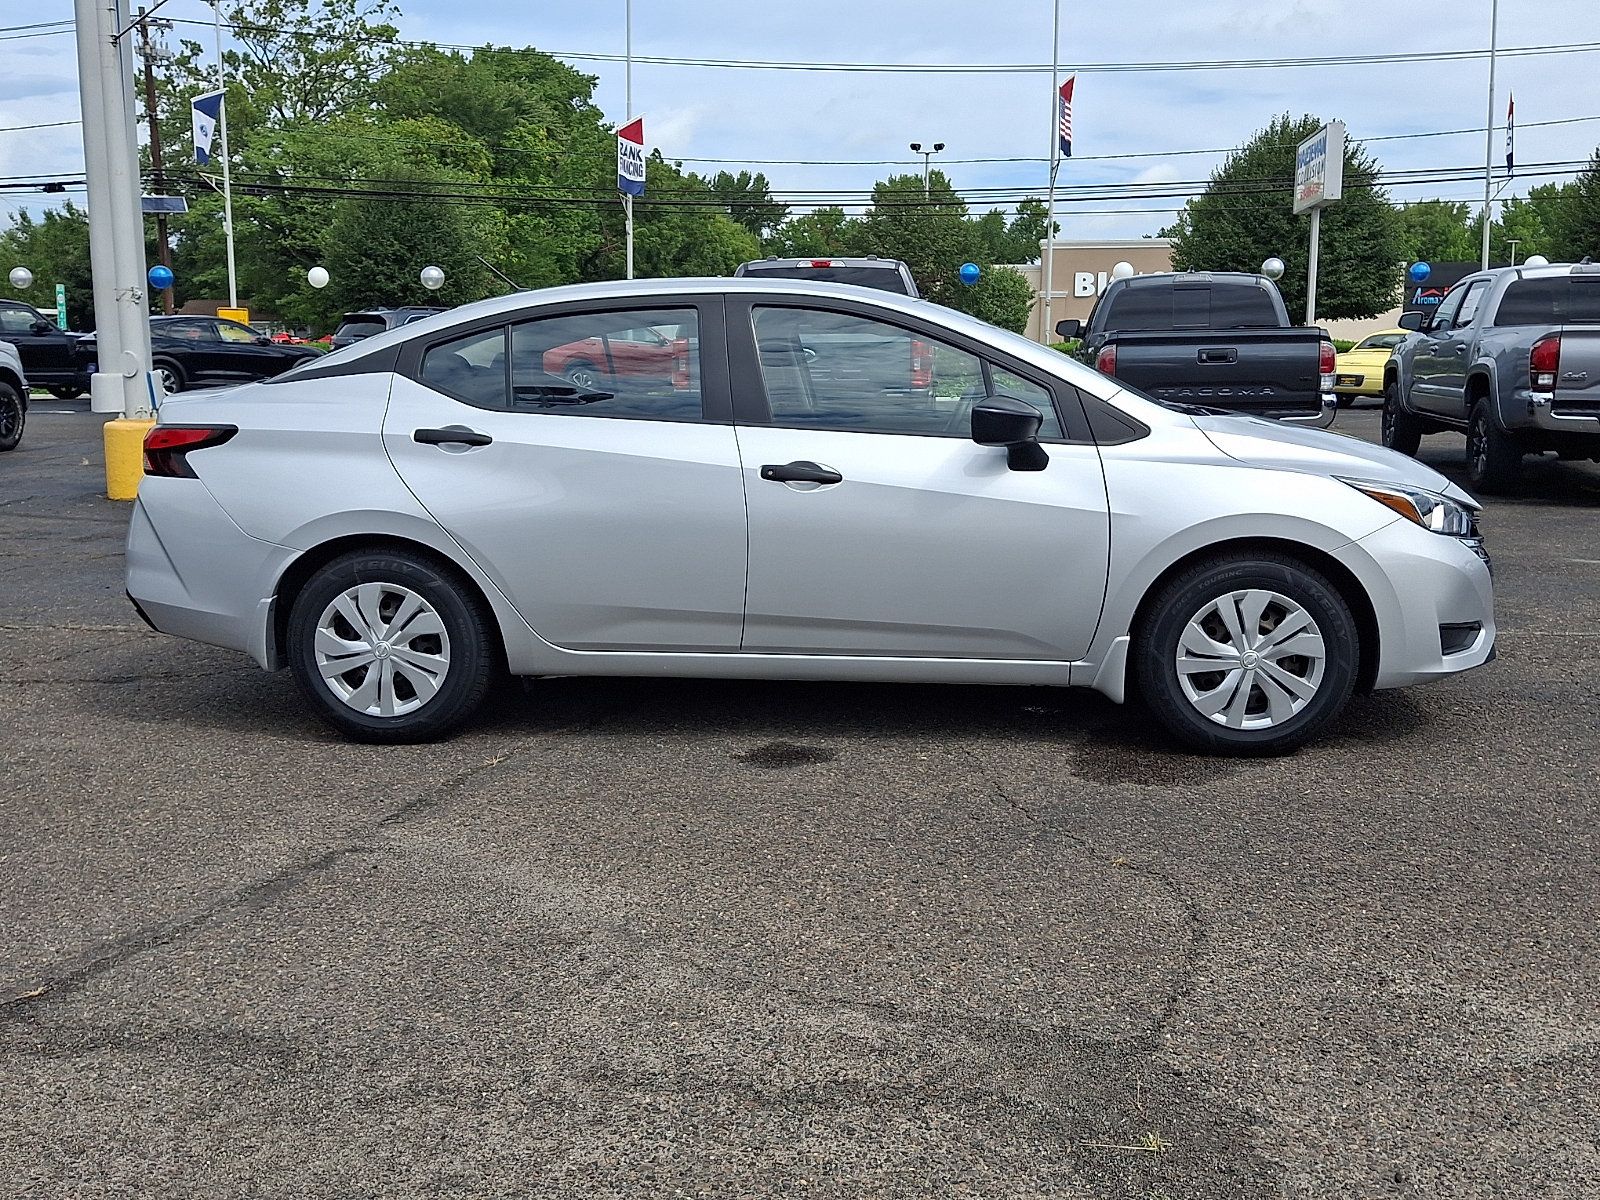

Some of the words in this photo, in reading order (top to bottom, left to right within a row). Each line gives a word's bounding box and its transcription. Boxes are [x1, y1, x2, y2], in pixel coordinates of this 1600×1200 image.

[1074, 271, 1113, 297] BI
[1157, 386, 1275, 396] TACOMA
[1199, 569, 1243, 589] TOURING
